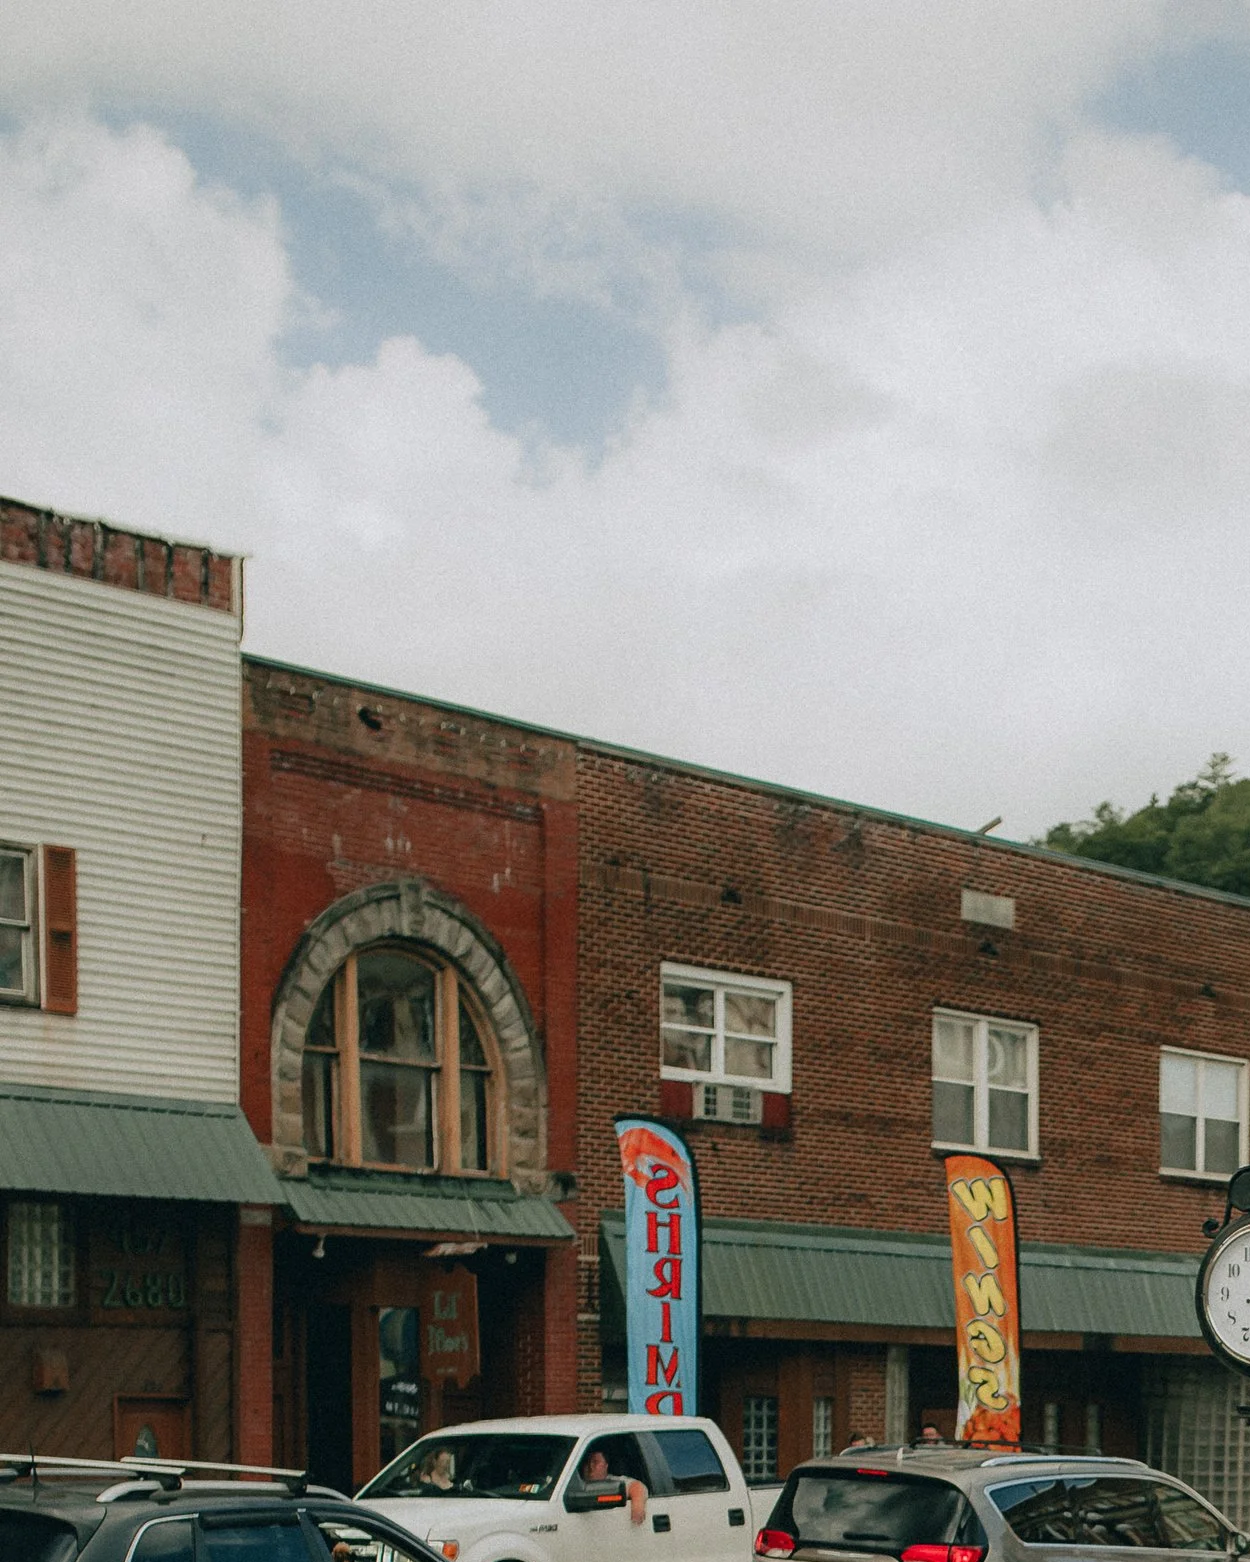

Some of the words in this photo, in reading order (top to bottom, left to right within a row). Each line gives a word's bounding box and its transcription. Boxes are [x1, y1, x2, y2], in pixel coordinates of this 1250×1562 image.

[1228, 1263, 1241, 1278] 10
[102, 1271, 185, 1308] 2680
[1220, 1286, 1230, 1301] 9
[1227, 1310, 1237, 1325] 8
[1241, 1327, 1250, 1342] 7
